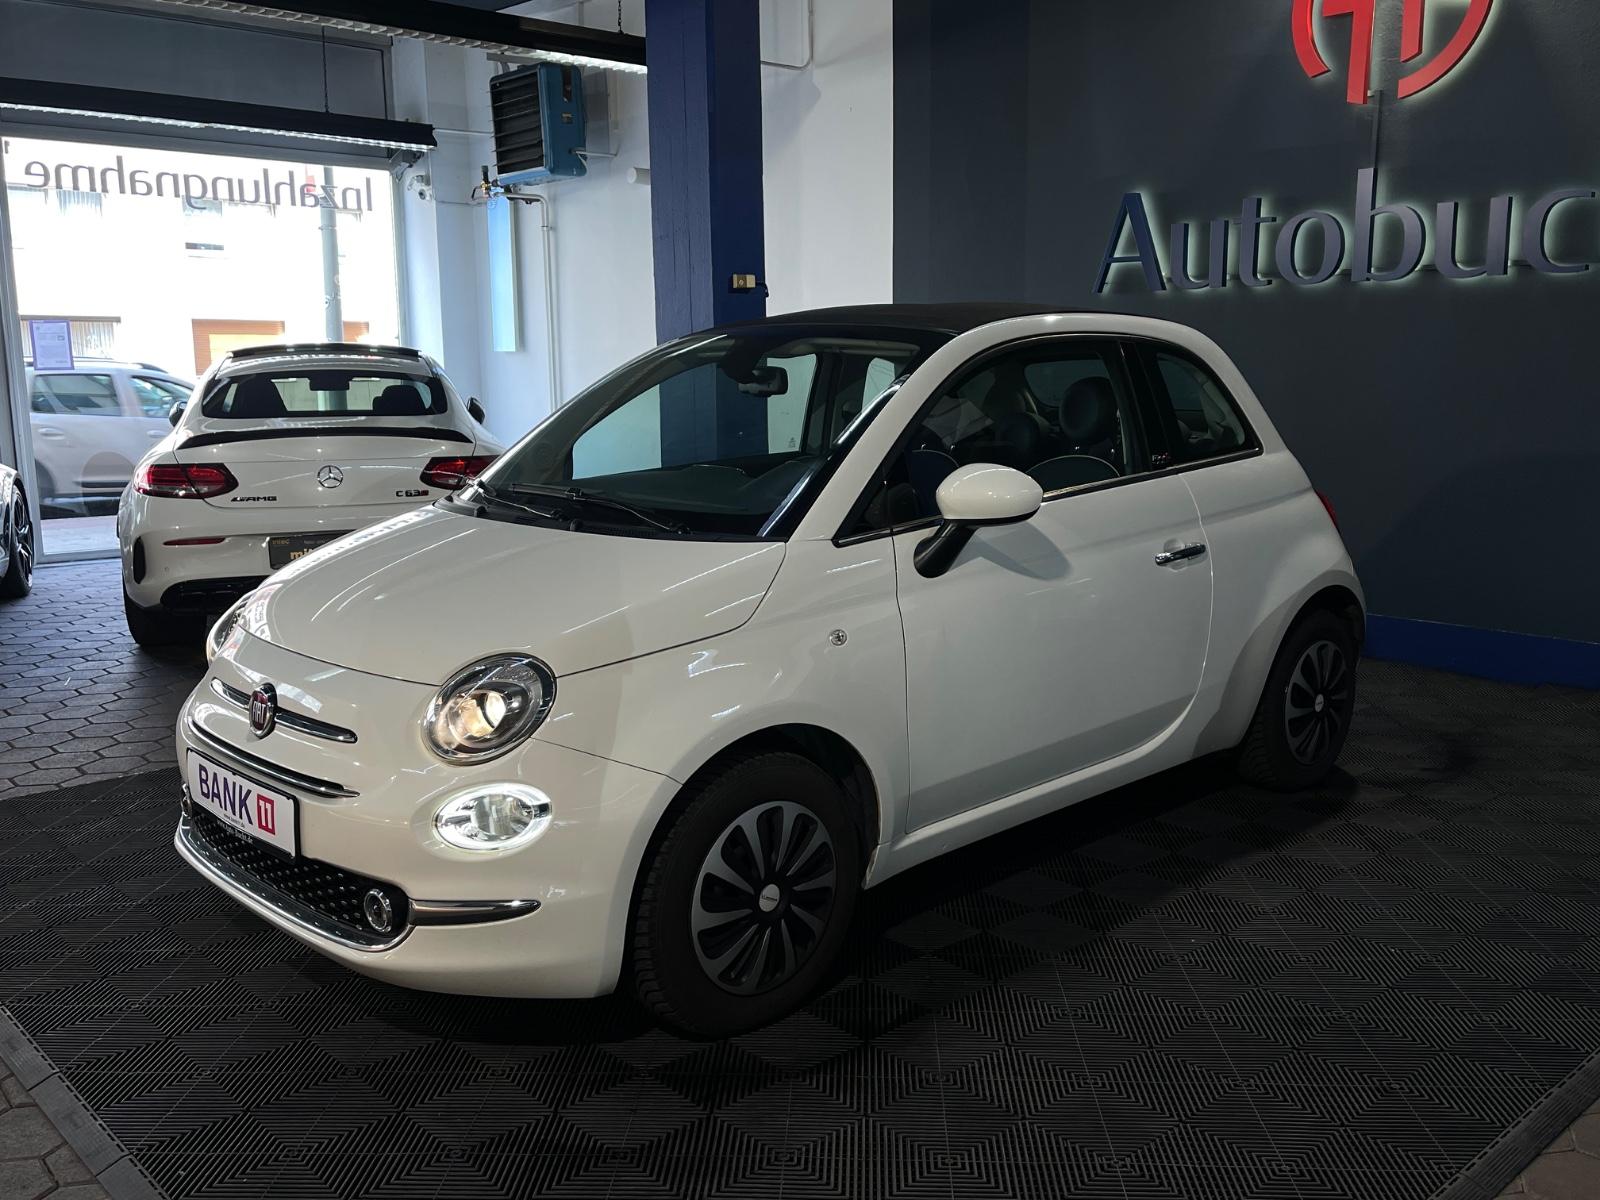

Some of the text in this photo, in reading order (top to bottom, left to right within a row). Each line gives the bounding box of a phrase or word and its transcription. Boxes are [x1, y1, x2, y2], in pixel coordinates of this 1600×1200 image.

[1091, 167, 1595, 293] Autobuc
[198, 763, 273, 830] BANK 11
